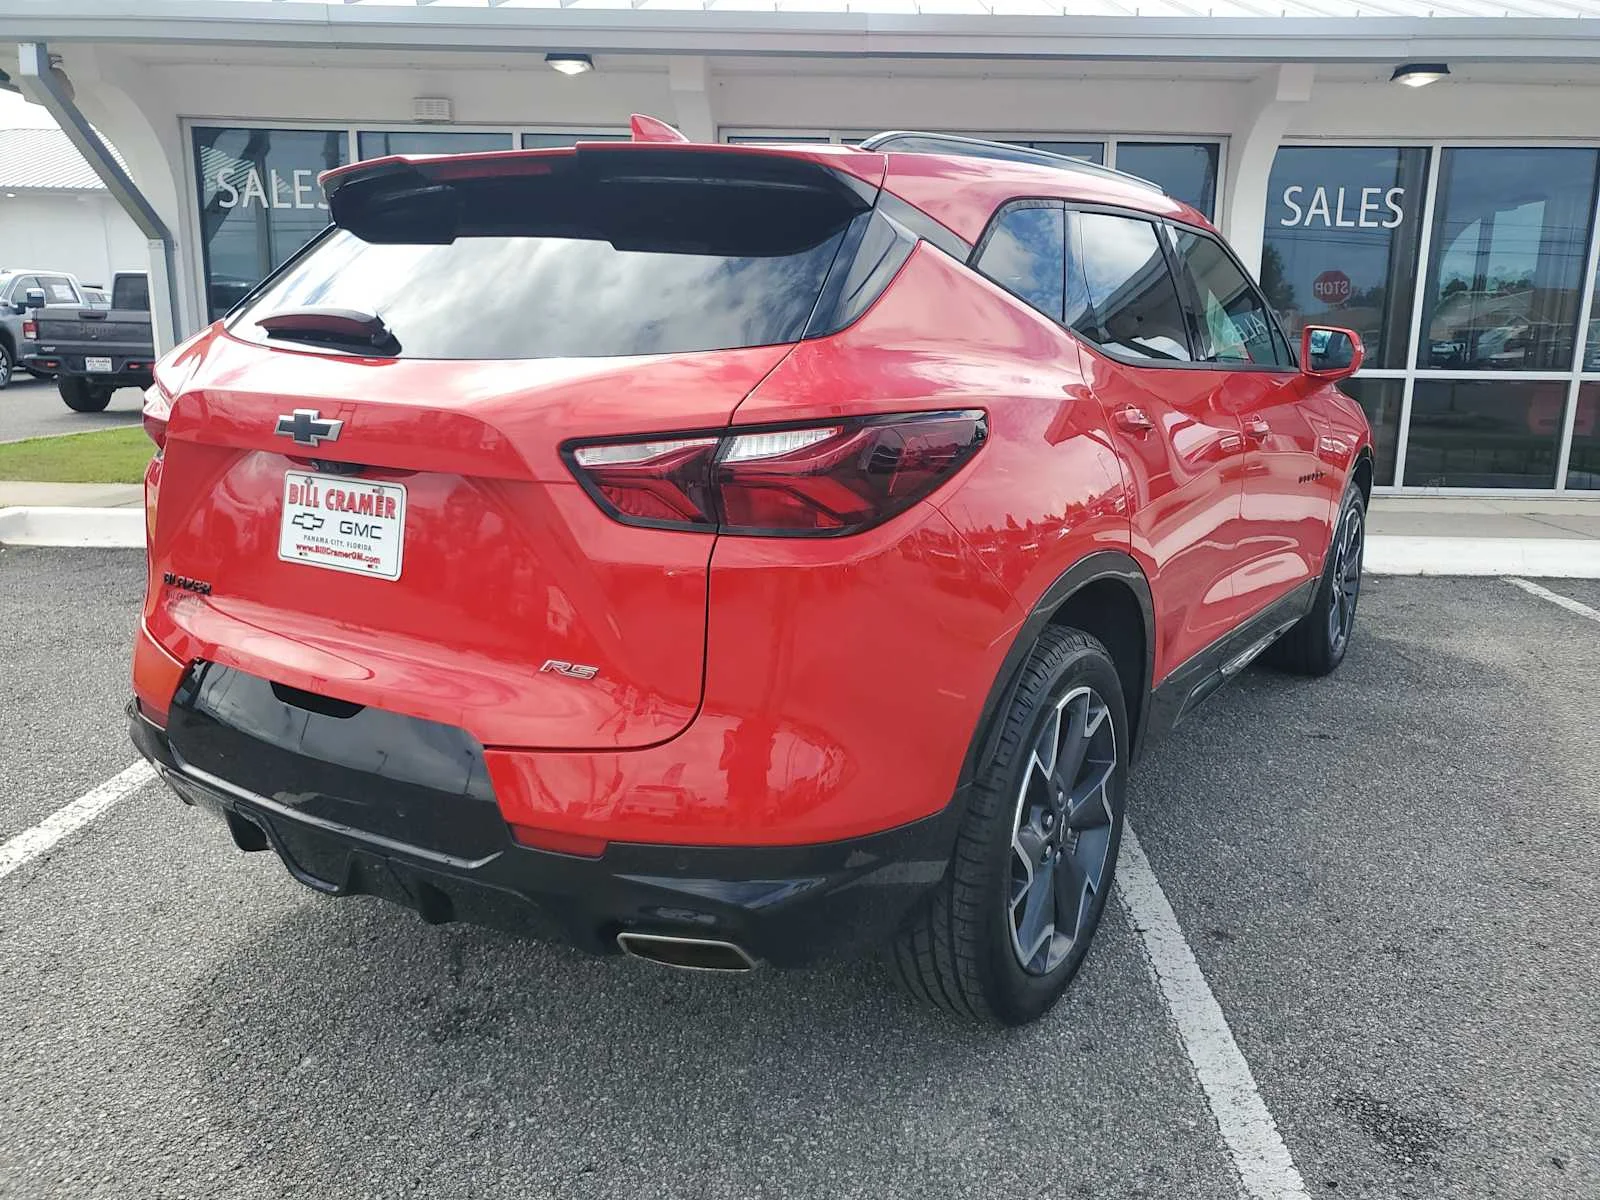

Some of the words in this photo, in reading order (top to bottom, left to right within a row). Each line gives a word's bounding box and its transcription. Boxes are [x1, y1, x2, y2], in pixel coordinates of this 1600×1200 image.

[217, 167, 329, 209] SALE
[1280, 185, 1406, 228] SALES
[288, 483, 320, 508] BILL
[325, 488, 397, 520] CRAMER
[303, 534, 329, 545] PANAMA
[346, 541, 372, 552] FLORIDA
[339, 520, 383, 540] GMC
[540, 659, 600, 680] RS
